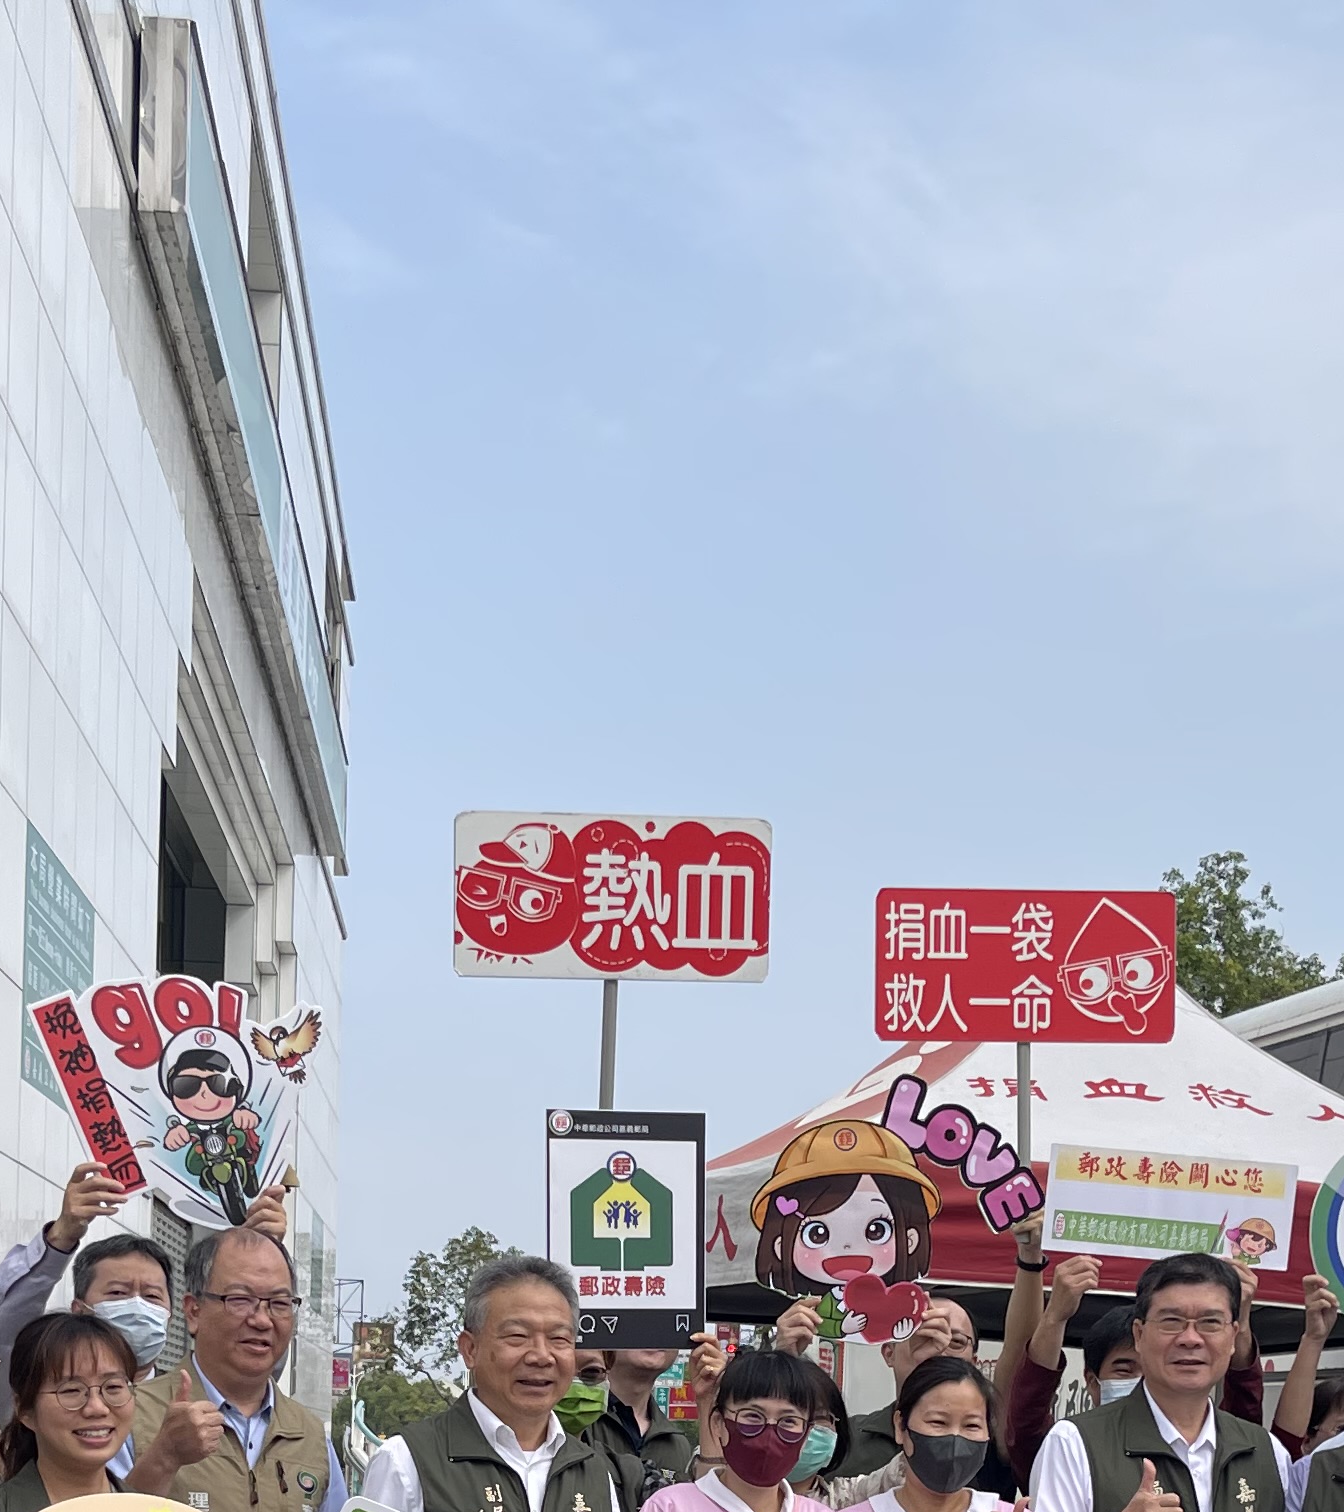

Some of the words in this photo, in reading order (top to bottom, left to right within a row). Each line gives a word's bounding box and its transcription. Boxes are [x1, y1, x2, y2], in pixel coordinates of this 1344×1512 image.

[581, 845, 760, 952] 熱血
[884, 902, 1054, 964] 捐血一袋
[884, 973, 1053, 1033] 救人一命
[883, 1074, 1045, 1232] LOVE
[1077, 1151, 1265, 1194] 郵政壽險關心您
[579, 1275, 666, 1297] 郵政壽險
